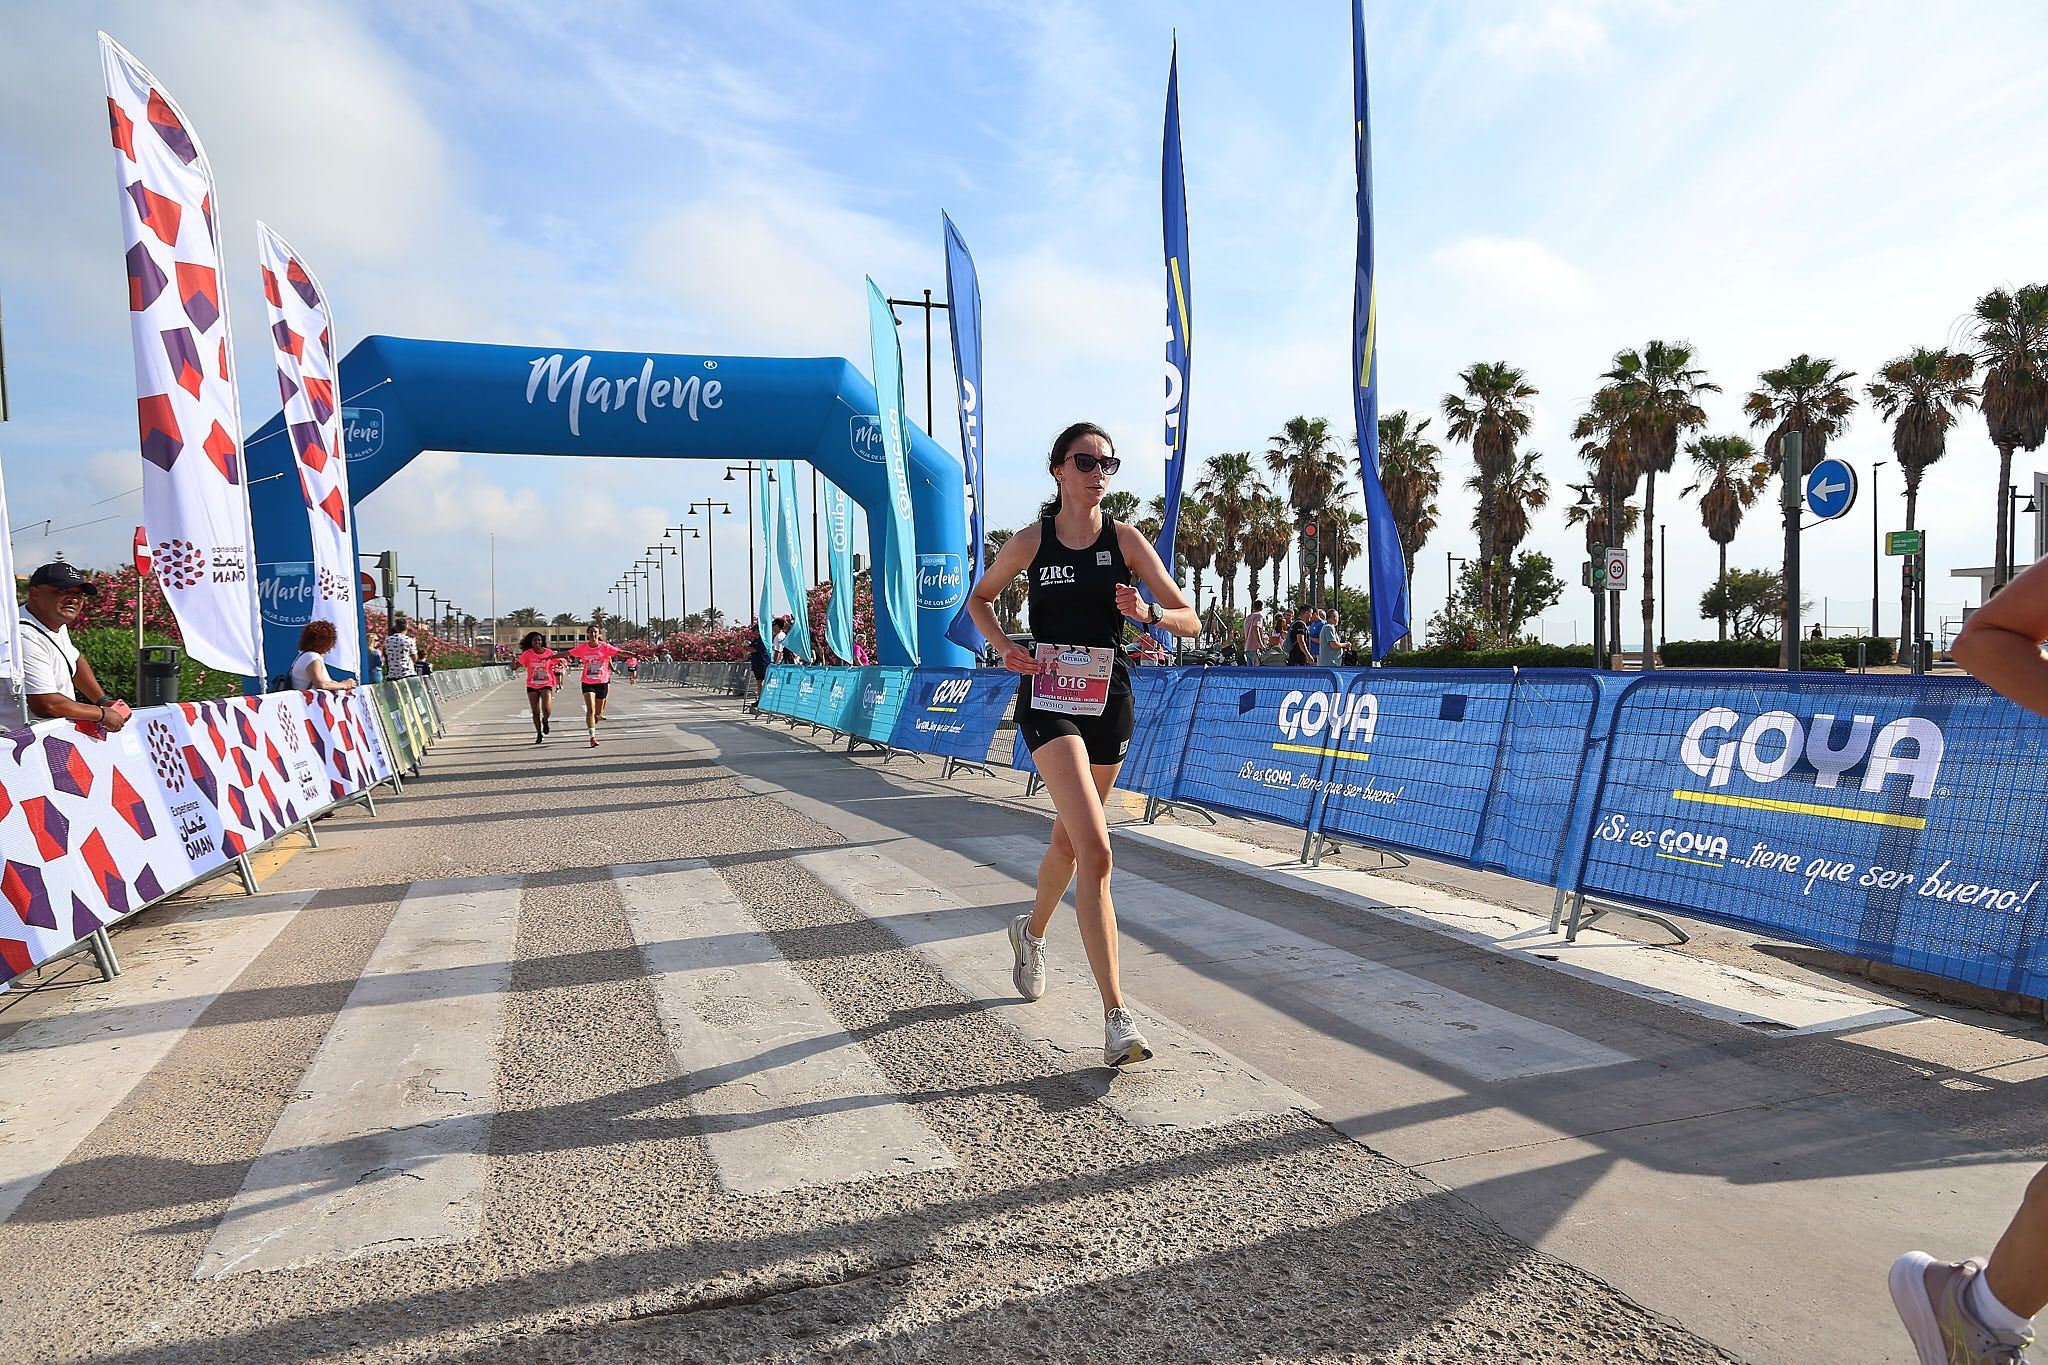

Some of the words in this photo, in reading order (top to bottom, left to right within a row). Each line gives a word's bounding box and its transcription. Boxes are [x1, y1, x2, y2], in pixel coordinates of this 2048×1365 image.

[526, 353, 723, 437] Marlene
[344, 420, 379, 442] lene
[1040, 565, 1075, 581] ZRC
[259, 576, 315, 610] Marle
[933, 680, 972, 705] GOYA
[1057, 676, 1087, 689] 016
[1040, 700, 1064, 710] OYSHO
[1279, 690, 1378, 742] GOYA
[1680, 707, 1944, 799] GOYA
[1237, 761, 1253, 779] ¡Si
[1253, 770, 1264, 781] es
[1265, 768, 1292, 785] GOYA
[1322, 781, 1343, 804] que
[1343, 783, 1362, 797] ser
[1362, 776, 1404, 805] bueno!
[170, 800, 200, 817] Experience
[186, 834, 215, 860] OMAN
[1593, 815, 1629, 842] ¡Si
[1630, 830, 1656, 847] es
[1659, 829, 1729, 860] GOYA
[1804, 857, 1855, 896] que
[1859, 866, 1914, 890] ser
[1918, 859, 2041, 913] bueno!
